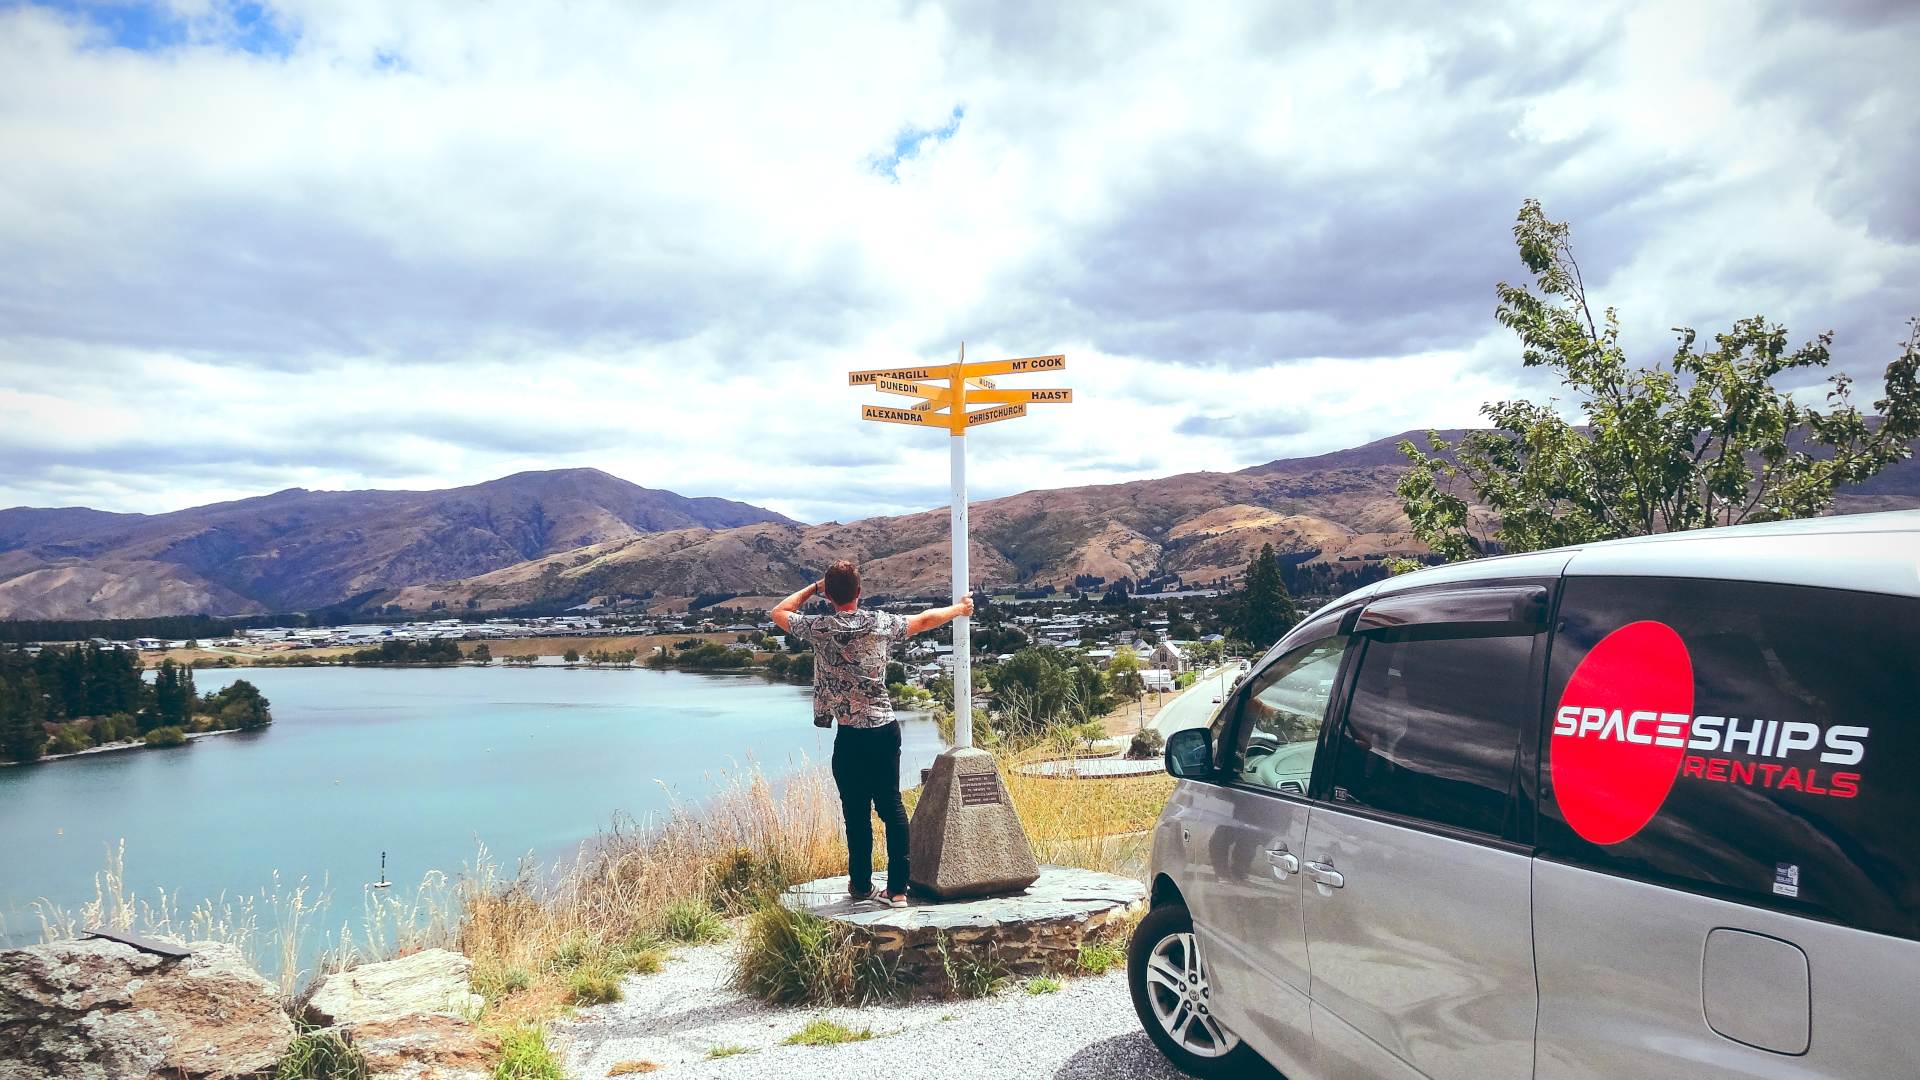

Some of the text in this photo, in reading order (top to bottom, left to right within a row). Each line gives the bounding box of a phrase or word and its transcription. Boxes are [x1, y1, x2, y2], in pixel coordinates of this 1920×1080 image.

[1012, 358, 1062, 370] MT COOK
[880, 380, 918, 393] DUNEDIN
[1031, 391, 1069, 399] HAAST
[866, 409, 923, 422] ALEXANDRA
[969, 404, 1024, 424] CHRISTCHURCH
[1683, 755, 1862, 799] RENTALS
